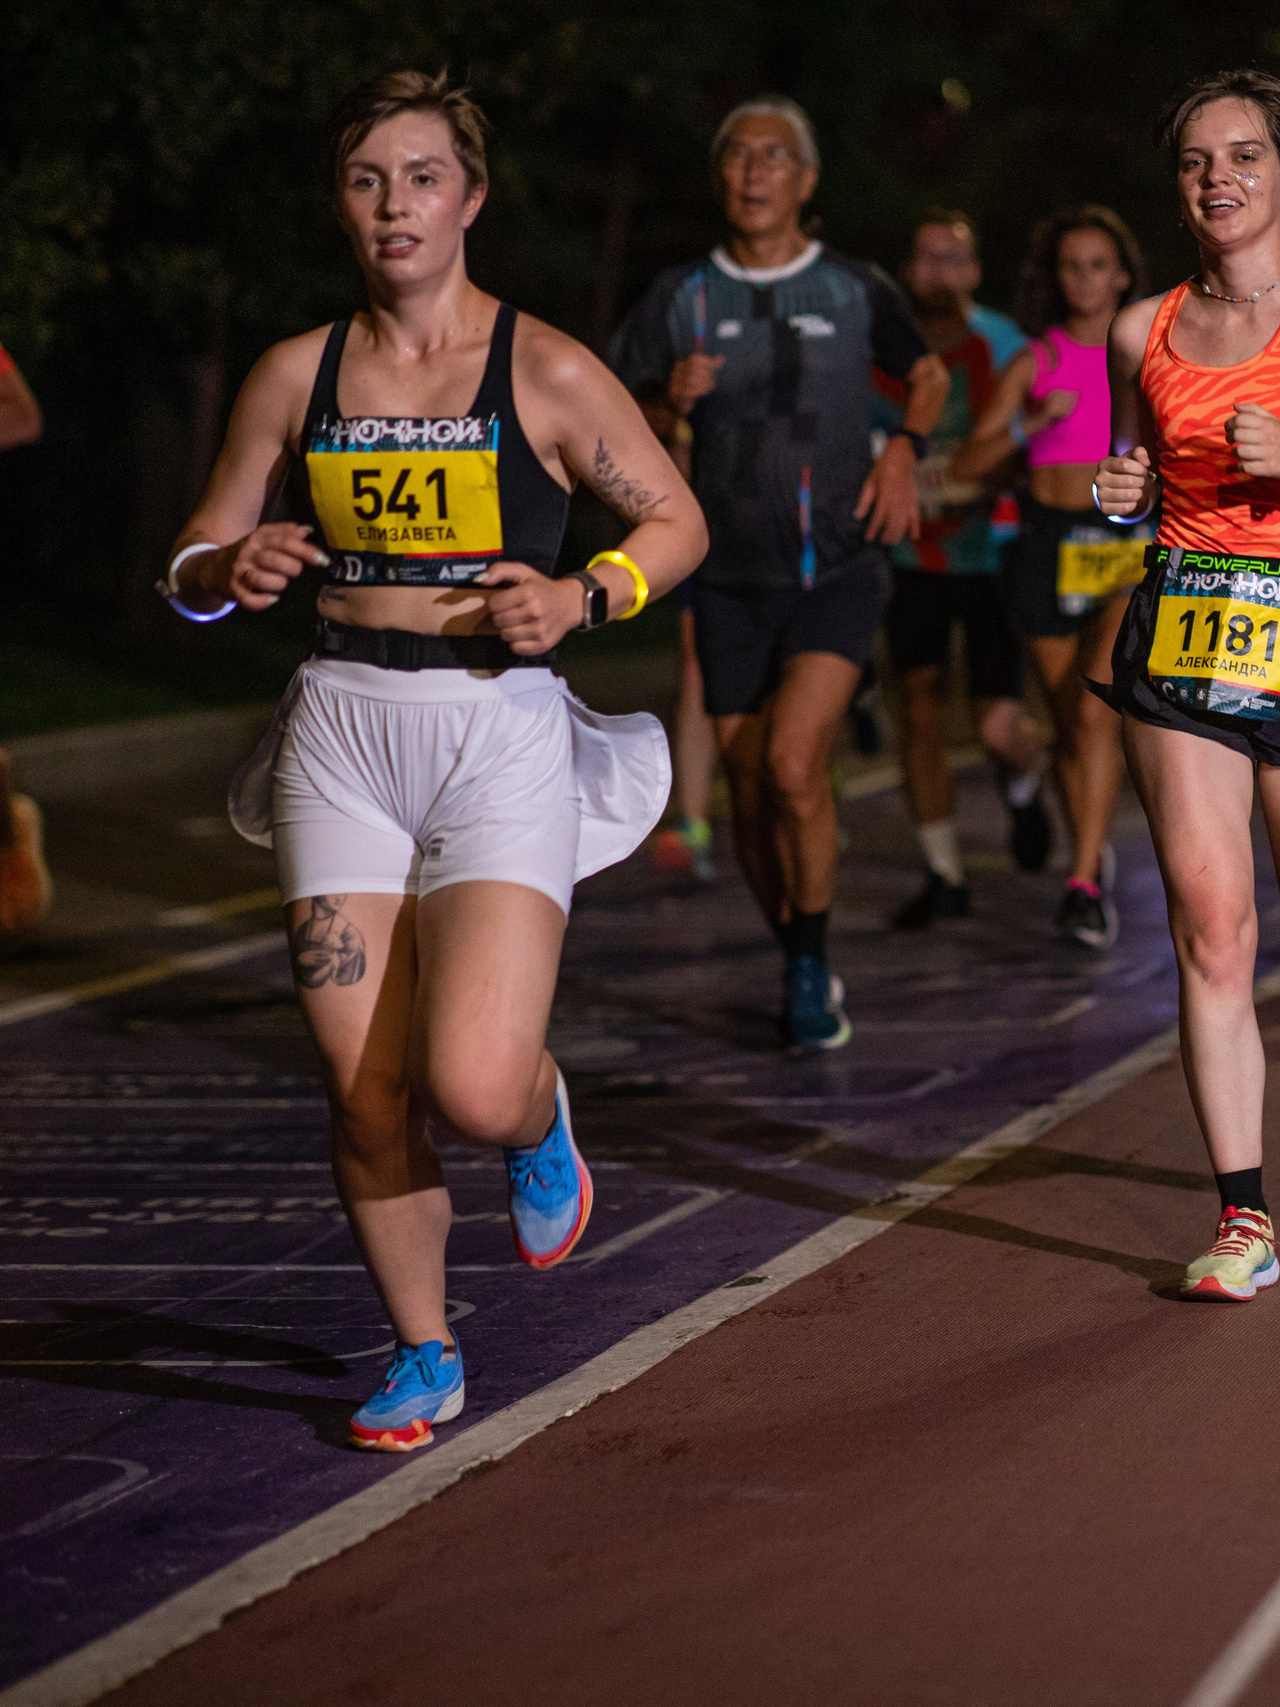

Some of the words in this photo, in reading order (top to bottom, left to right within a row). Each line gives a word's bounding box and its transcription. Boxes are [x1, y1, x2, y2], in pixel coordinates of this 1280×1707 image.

[331, 417, 484, 445] НОЧНОЙ
[352, 468, 448, 522] 541
[356, 526, 457, 542] ЕЛИЗАВЕТА
[1178, 609, 1279, 662] 1181
[1174, 655, 1267, 679] АЛЕКСАНДРА
